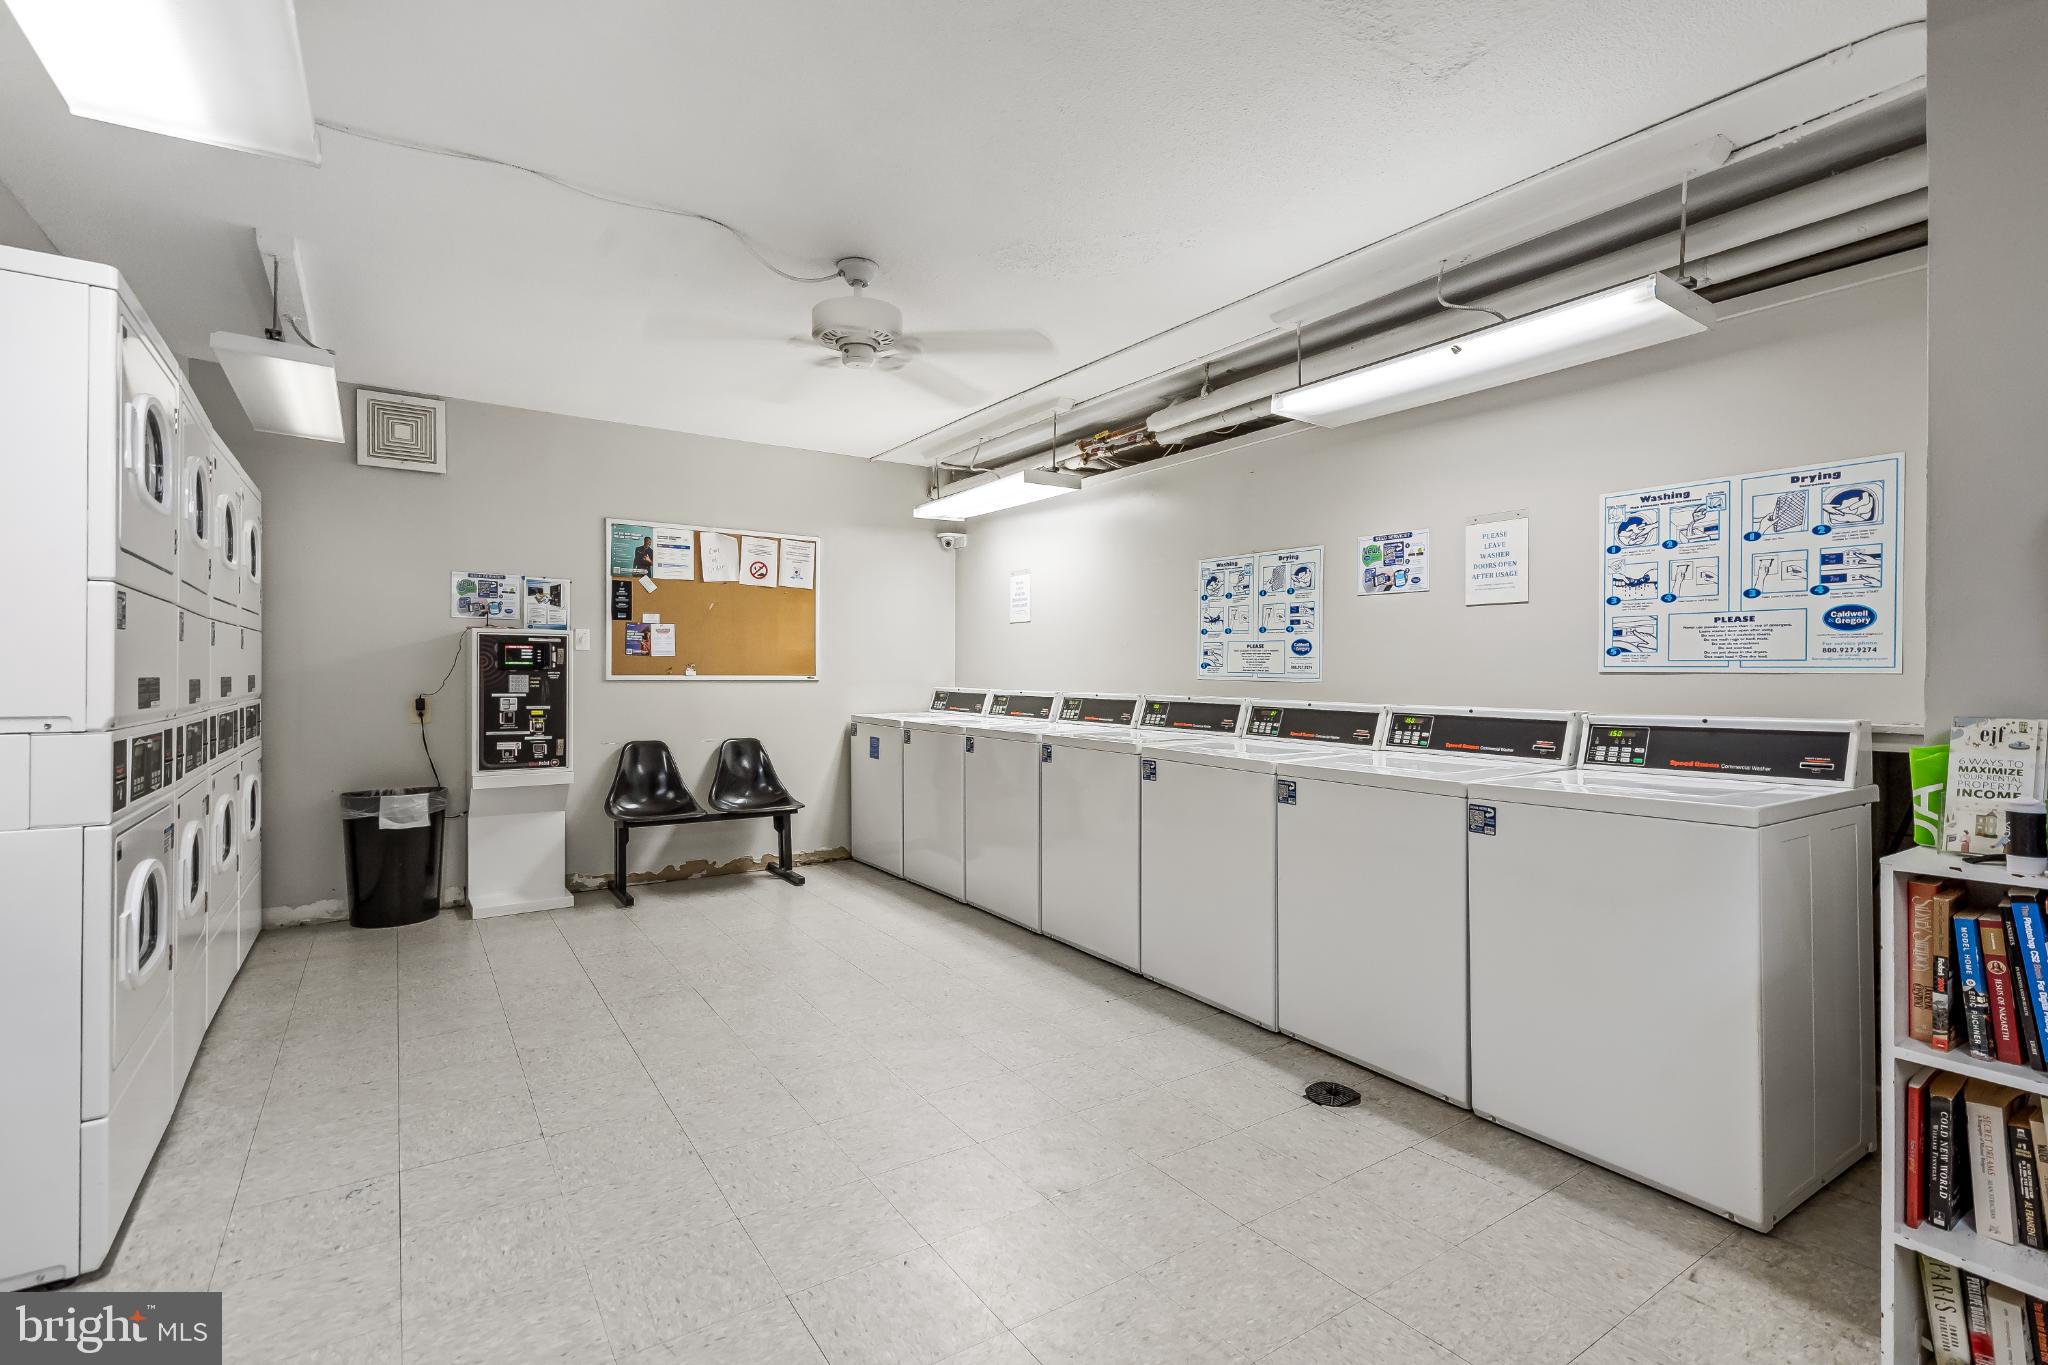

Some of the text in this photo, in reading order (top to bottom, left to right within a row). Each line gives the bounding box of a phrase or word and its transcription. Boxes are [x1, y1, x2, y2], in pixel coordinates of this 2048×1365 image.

[1790, 472, 1841, 484] Drying
[1640, 491, 1690, 503] Washing
[1482, 531, 1507, 539] PLEASE
[1363, 545, 1380, 554] NEW!
[1480, 551, 1510, 559] WASHER
[1980, 726, 2006, 746] ejf
[1958, 766, 2024, 776] MAXIMIZE
[1969, 758, 2003, 767] WAYS
[2009, 760, 2024, 768] TO
[1958, 781, 2022, 792] PROPERTY
[1986, 775, 2021, 783] RENTAL
[1957, 789, 2022, 799] INCOME
[1912, 895, 1932, 934] SIDNEY
[2020, 905, 2029, 916] The
[2023, 917, 2036, 949] Photoshop
[1912, 932, 1932, 972] SHELDON
[1961, 927, 1973, 974] MODEL HOME
[2030, 950, 2040, 963] CS2
[2037, 981, 2045, 990] For
[1968, 990, 1981, 1045] ERIC PUCHNER
[1994, 978, 2010, 1041] JESUS OF NAZARETH
[1940, 1140, 1948, 1161] NEW
[1982, 1115, 1995, 1176] SECRET DREAMS
[1939, 1161, 1948, 1199] WORLD
[2025, 1209, 2036, 1236] FRANKEN
[1966, 1276, 1983, 1307] PENELOPE
[1970, 1306, 1986, 1334] DOUGLAS
[1950, 1324, 1959, 1348] EDWARD
